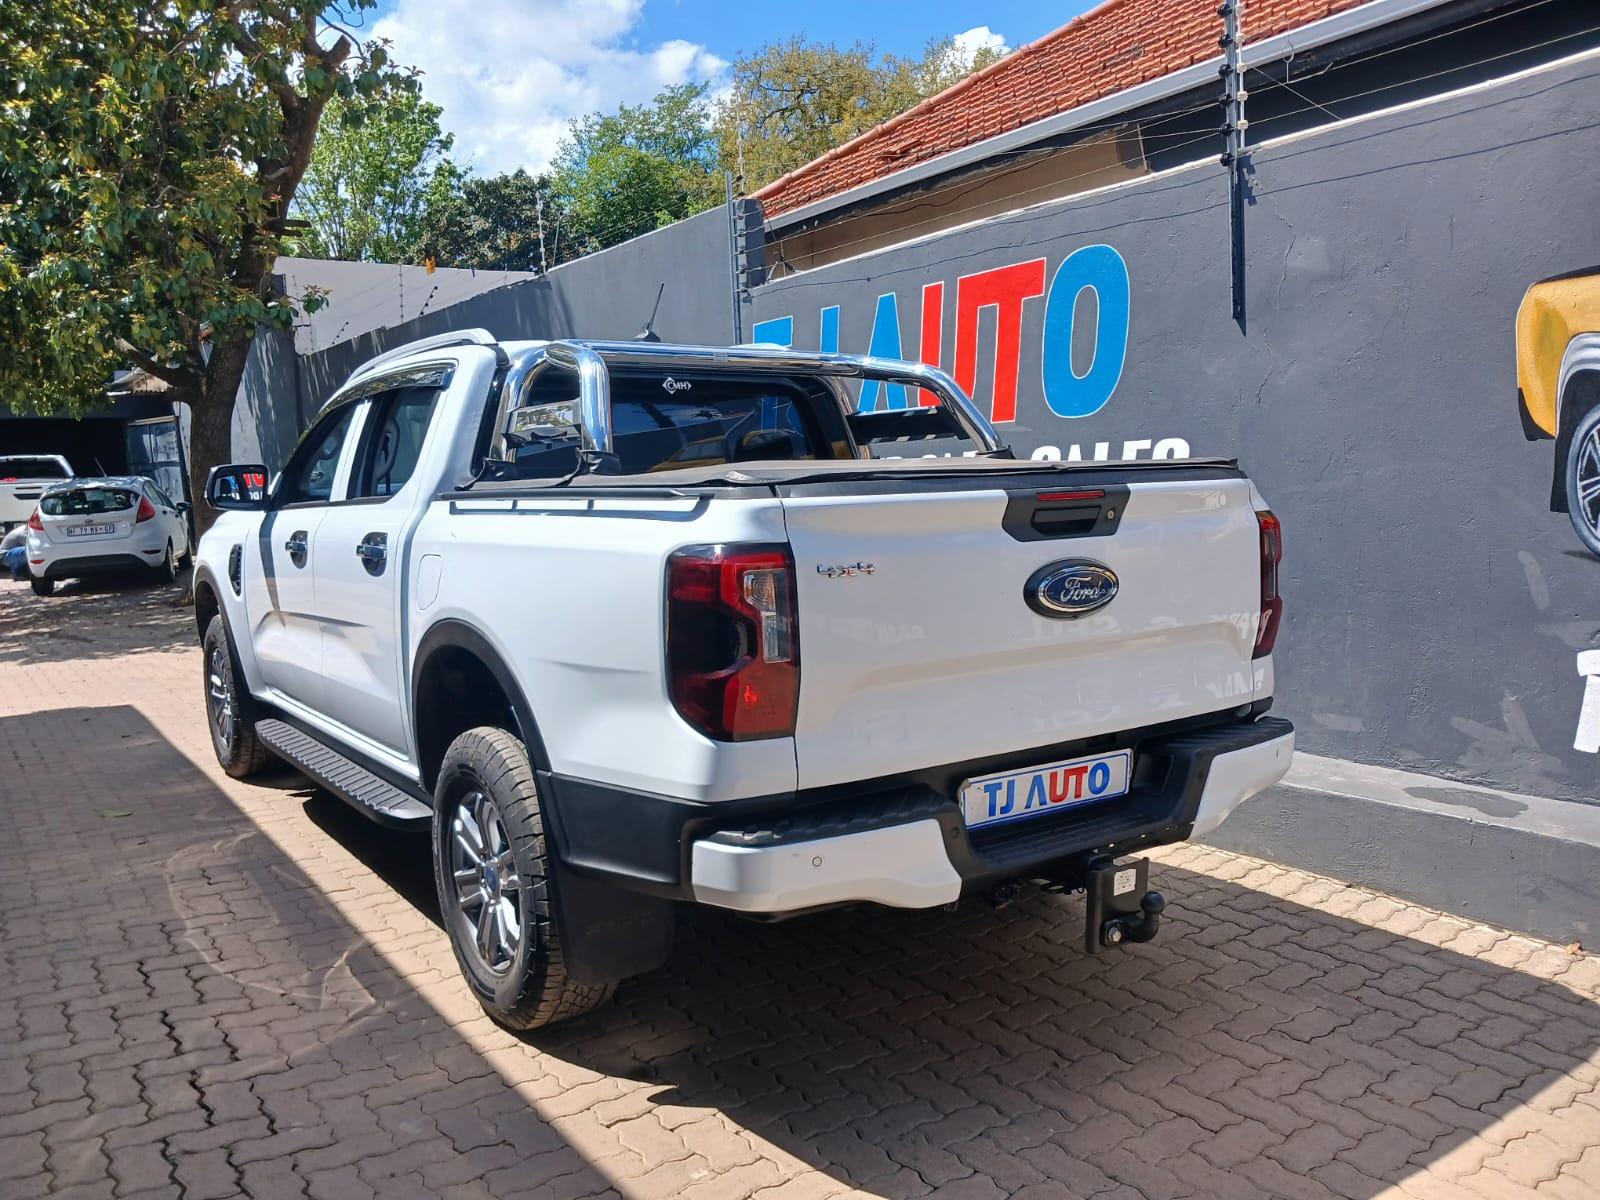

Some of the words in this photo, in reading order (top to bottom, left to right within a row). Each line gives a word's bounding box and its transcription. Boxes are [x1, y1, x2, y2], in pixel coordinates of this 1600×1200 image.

[857, 244, 1130, 424] AUTO
[1061, 576, 1102, 602] Ford
[984, 779, 1015, 817] TJ
[1025, 762, 1110, 809] AUTO
